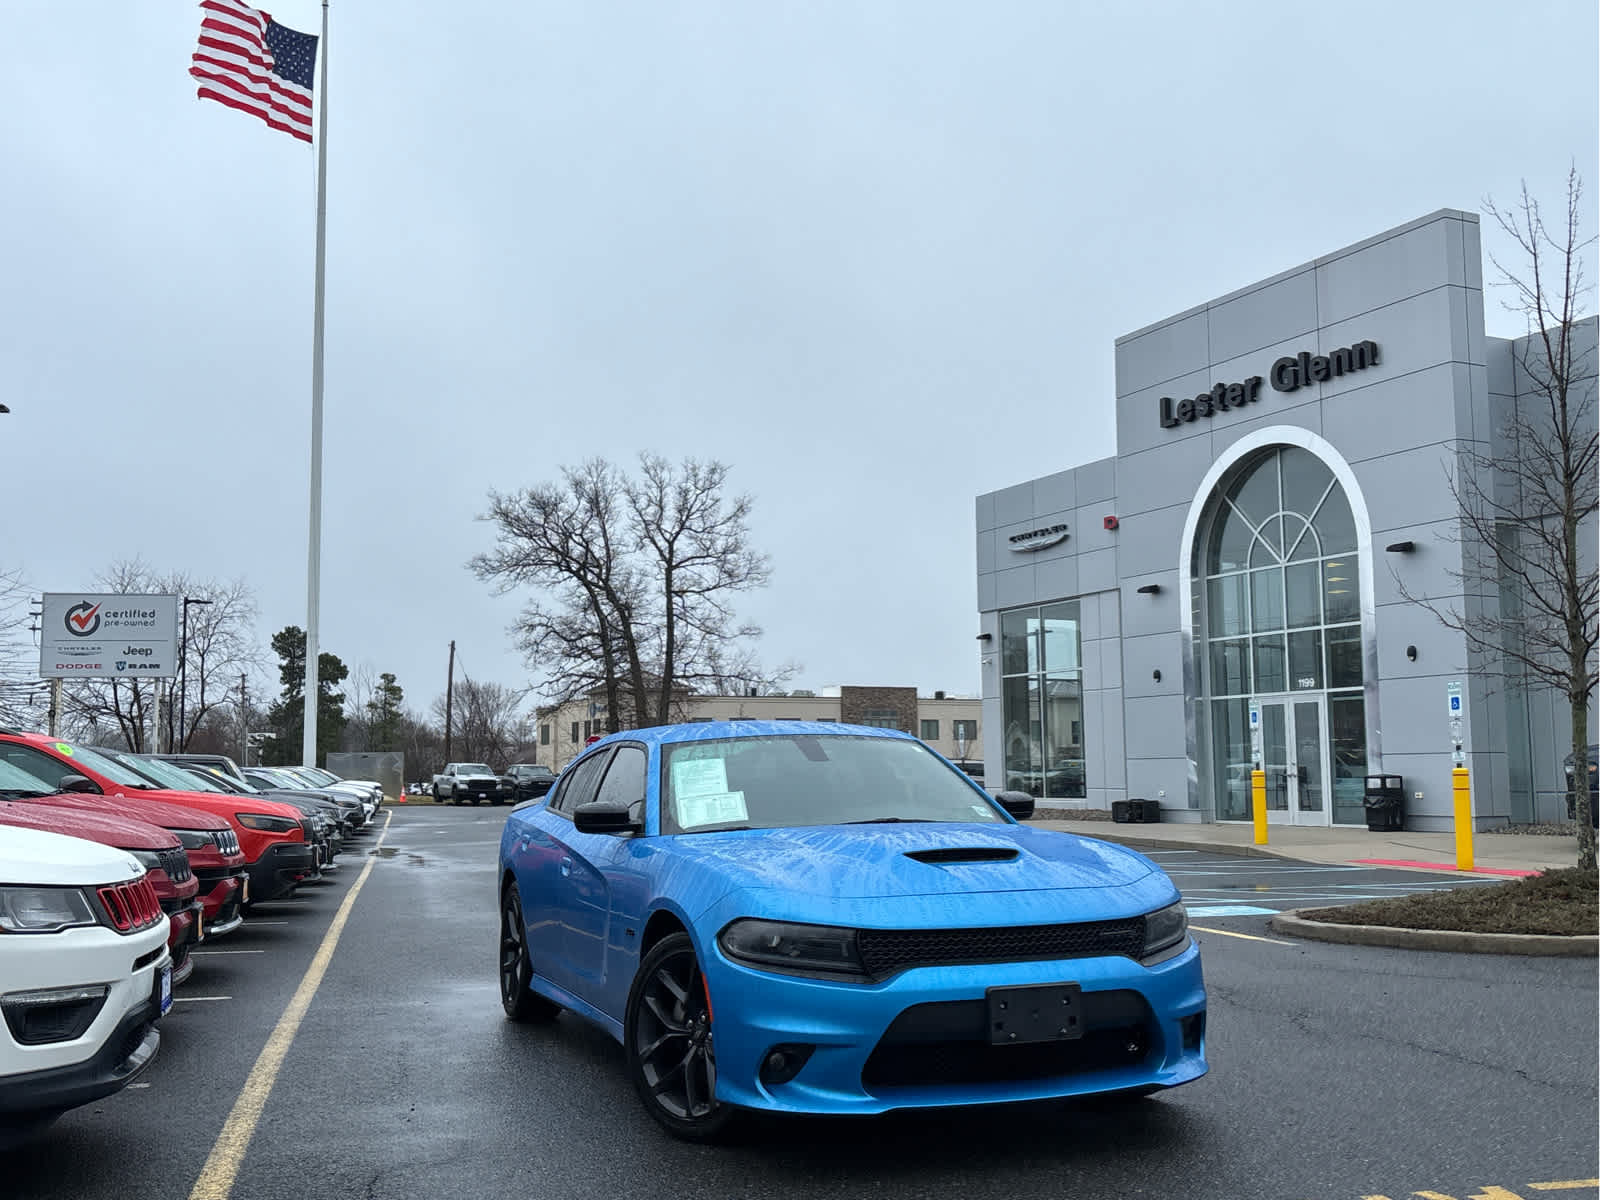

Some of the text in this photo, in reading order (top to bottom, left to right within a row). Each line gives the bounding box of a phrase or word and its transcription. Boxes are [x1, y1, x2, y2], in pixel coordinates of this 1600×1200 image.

[1159, 340, 1380, 429] Lester Glenn
[104, 609, 156, 618] certified
[104, 619, 156, 628] pre-owned
[122, 645, 153, 657] Jeep
[1298, 677, 1315, 688] 1199
